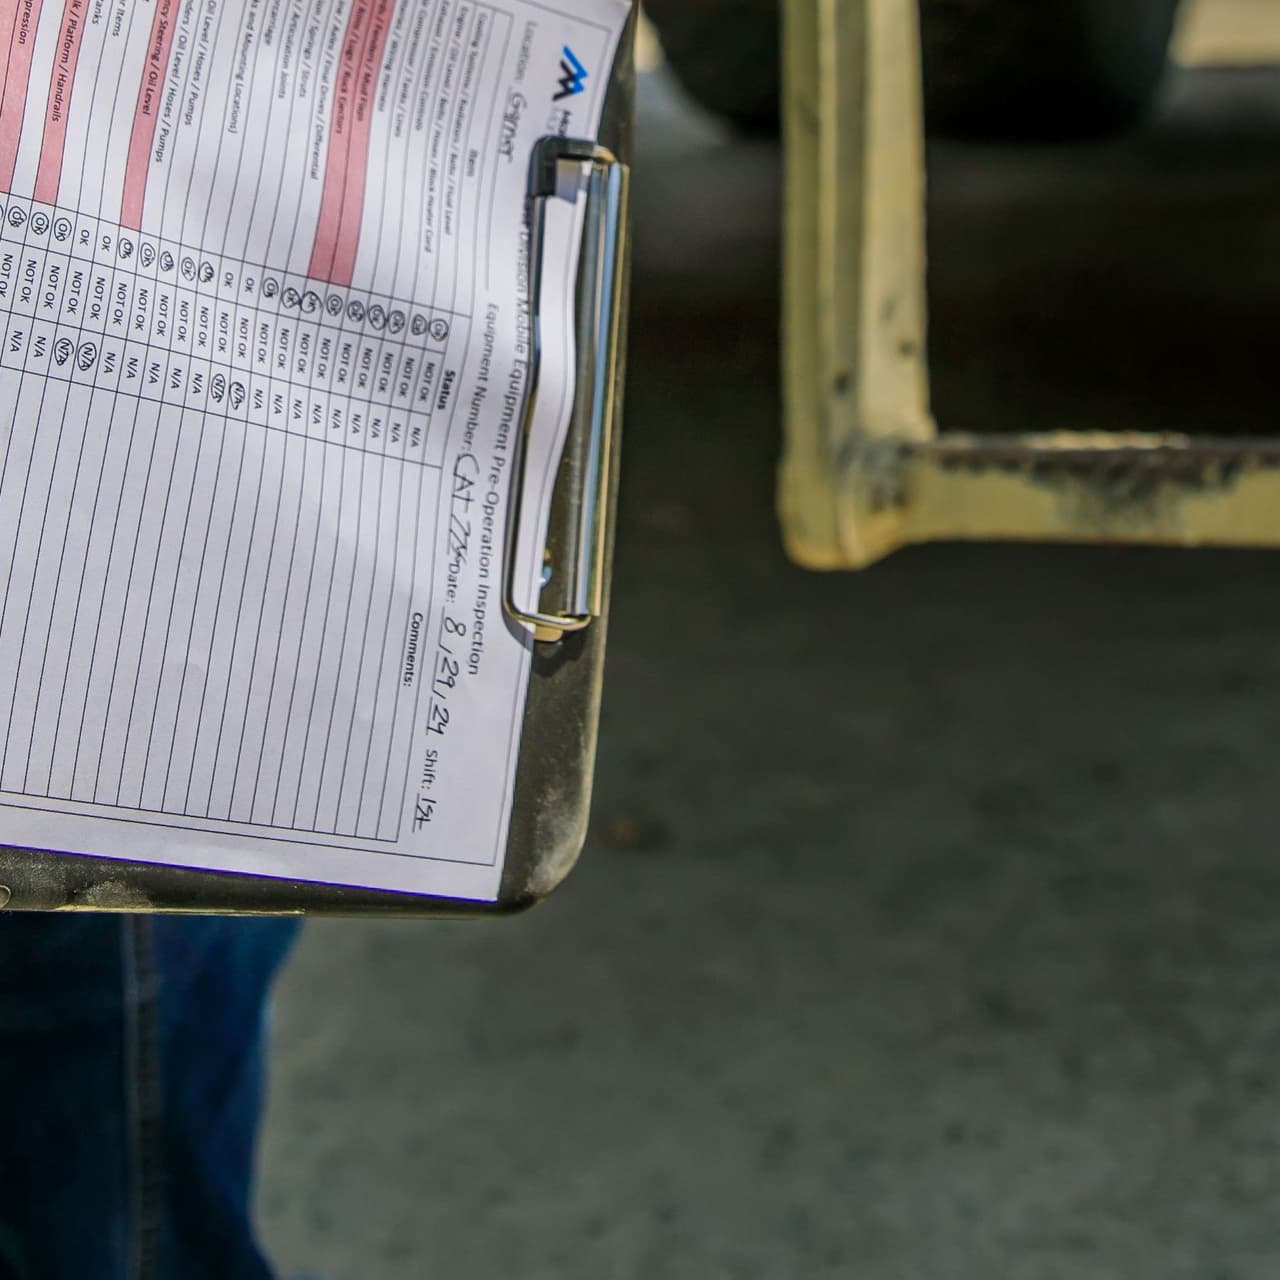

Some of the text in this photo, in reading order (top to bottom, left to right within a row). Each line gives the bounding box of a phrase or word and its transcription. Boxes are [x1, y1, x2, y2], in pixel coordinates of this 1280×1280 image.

[112, 8, 125, 37] Items
[205, 0, 217, 15] Oil
[246, 10, 258, 30] and
[62, 19, 78, 63] Platform
[152, 20, 167, 61] Steering
[176, 34, 188, 50] Oil
[201, 16, 212, 42] Level
[172, 52, 183, 77] Level
[193, 52, 205, 81] Hoses
[237, 32, 253, 80] Mounting
[51, 73, 68, 121] Handrails
[147, 70, 158, 86] Oil
[142, 88, 154, 115] Level
[164, 88, 176, 117] Hoses
[185, 92, 198, 125] Pumps
[228, 83, 245, 133] Locations)
[156, 129, 168, 162] Pumps
[79, 229, 90, 245] OK
[66, 270, 83, 314] NOT OK
[223, 271, 233, 287] OK
[134, 288, 148, 330] NOT OK
[216, 312, 228, 352] NOT OK
[256, 323, 269, 363] NOT OK
[125, 357, 138, 379] N/A
[377, 352, 393, 393] NOT OK
[464, 302, 498, 452] Equipment Number:
[252, 388, 263, 410] N/A
[438, 369, 454, 410] Status
[497, 357, 525, 452] Equipment
[370, 418, 381, 439] N/A
[476, 455, 506, 577] Pre-Operation
[445, 563, 460, 602] Date:
[403, 612, 422, 686] Comments:
[466, 584, 491, 675] Inspection
[422, 749, 437, 789] Shift:
